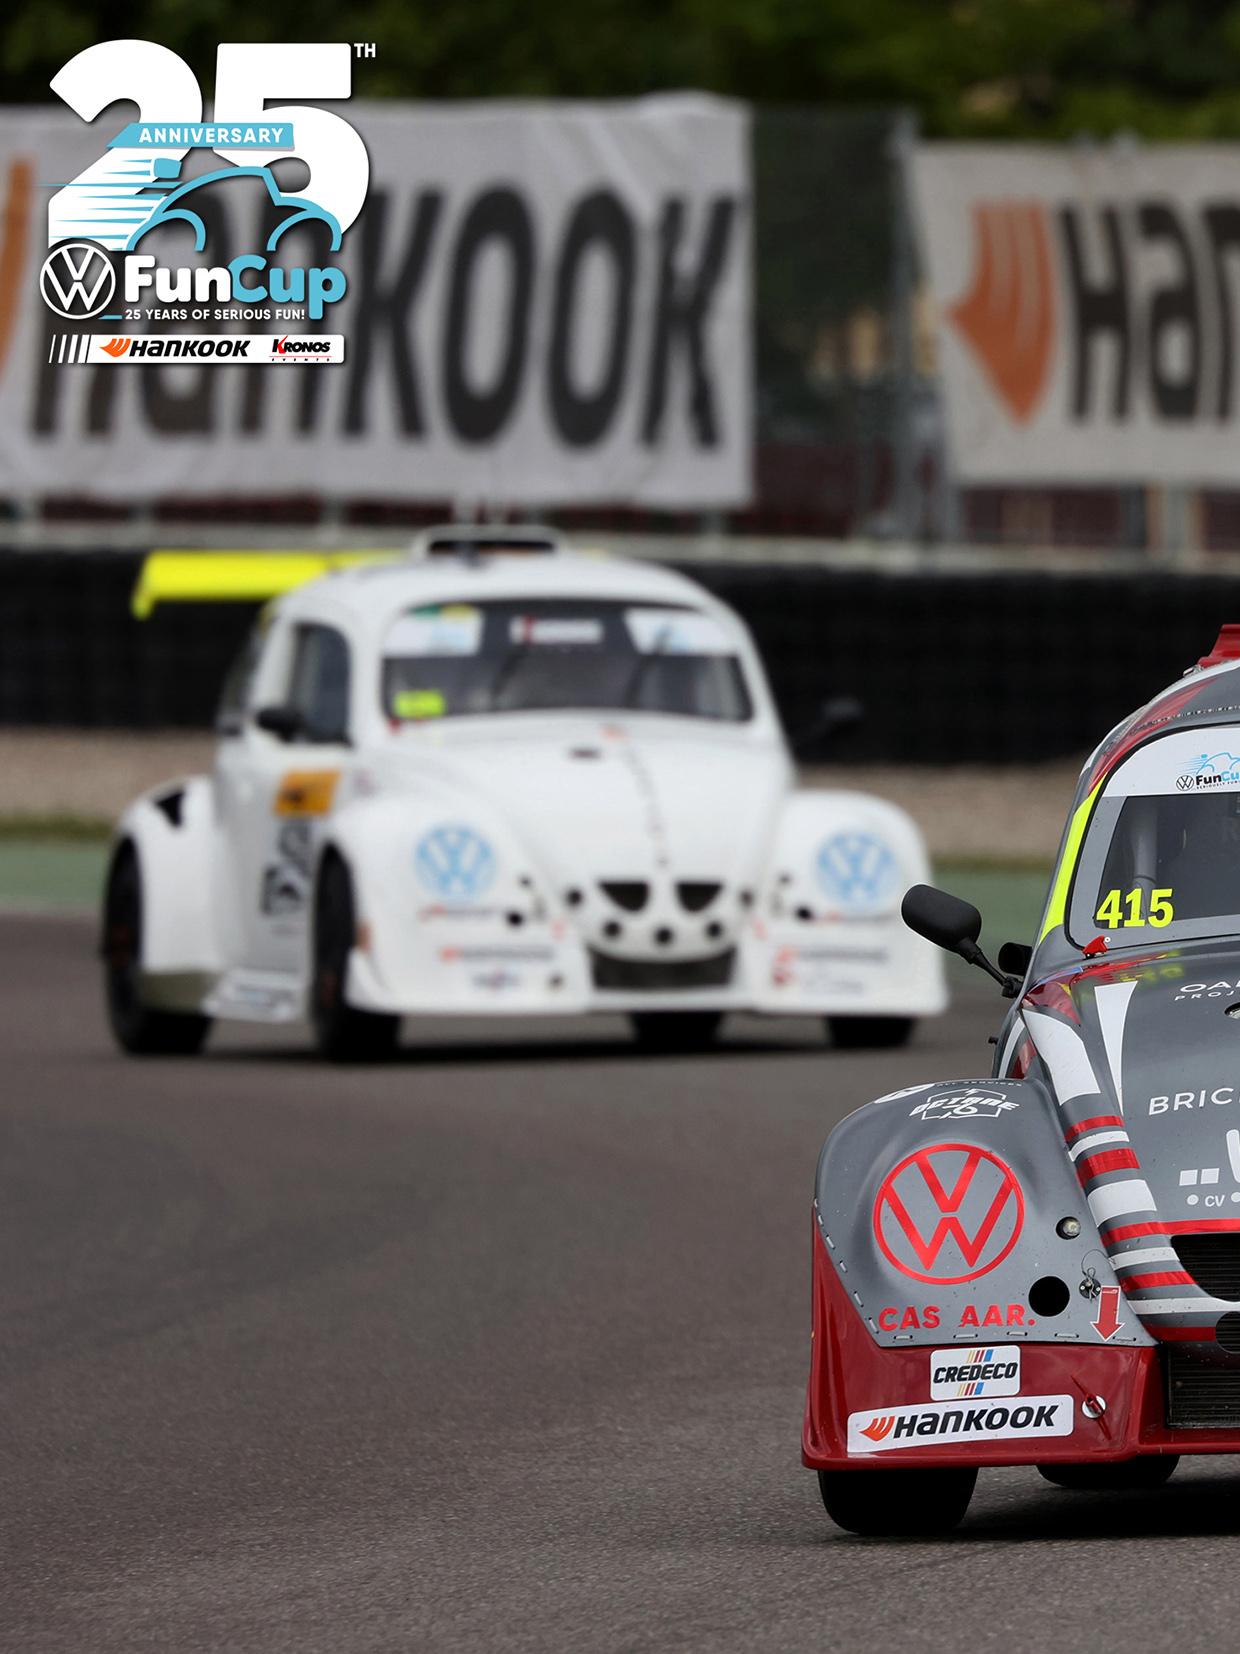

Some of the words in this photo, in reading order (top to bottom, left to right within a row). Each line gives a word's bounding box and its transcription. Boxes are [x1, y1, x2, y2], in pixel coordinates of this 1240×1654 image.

[1096, 888, 1174, 929] 415
[1204, 1194, 1226, 1208] cv
[878, 1305, 941, 1332] CAS
[957, 1303, 1036, 1328] AAR.
[933, 1361, 1018, 1384] CREDECO
